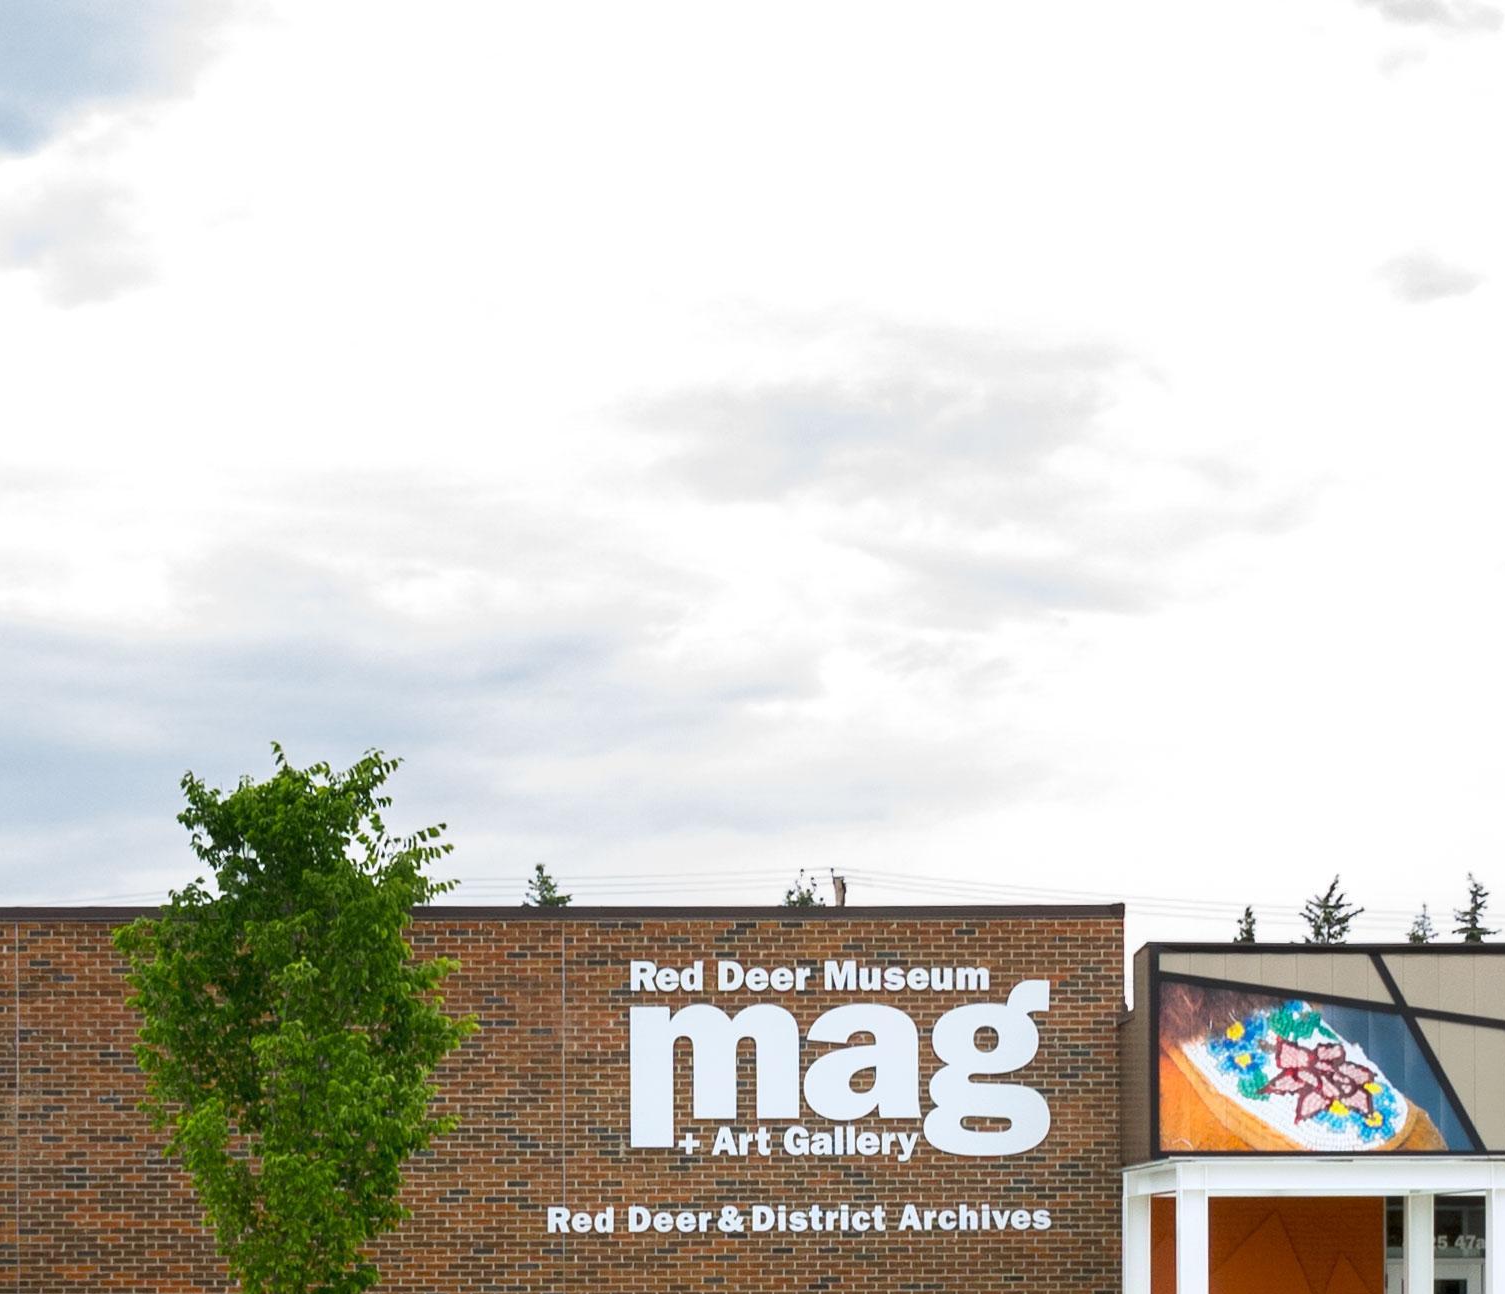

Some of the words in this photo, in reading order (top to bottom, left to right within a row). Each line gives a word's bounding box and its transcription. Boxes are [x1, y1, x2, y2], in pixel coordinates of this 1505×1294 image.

[630, 960, 704, 992] Red
[717, 960, 811, 992] Deer
[824, 960, 990, 992] Museum
[629, 979, 1051, 1156] mag
[678, 1132, 701, 1155] +
[711, 1126, 772, 1156] Art
[783, 1125, 919, 1162] Gallery
[547, 1206, 615, 1233] Red
[628, 1205, 712, 1233] Deer
[717, 1205, 744, 1233] &
[752, 1204, 886, 1232] District
[898, 1204, 1052, 1231] Archives
